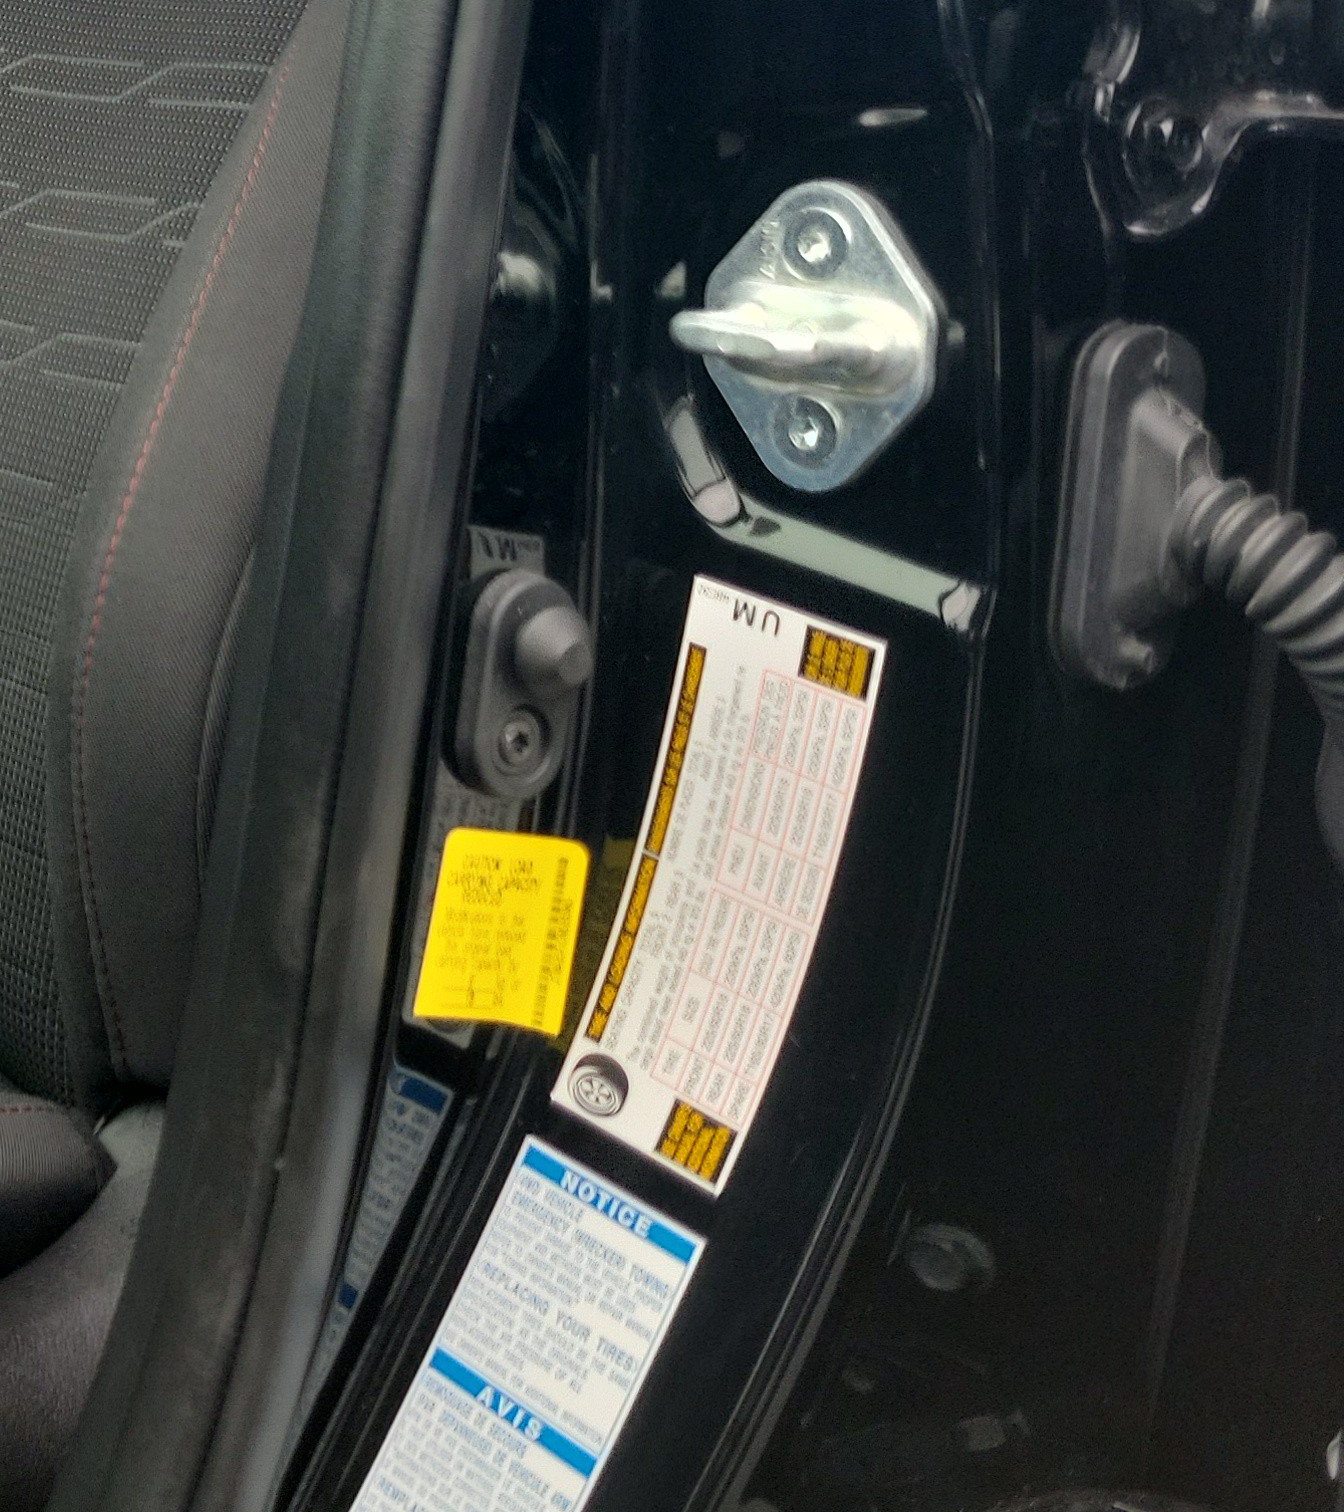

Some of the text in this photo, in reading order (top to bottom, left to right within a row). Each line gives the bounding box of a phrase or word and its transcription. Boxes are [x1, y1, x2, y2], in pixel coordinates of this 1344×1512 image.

[731, 598, 782, 638] UM
[559, 1168, 654, 1238] NOTICE
[475, 1383, 545, 1442] AVIS
